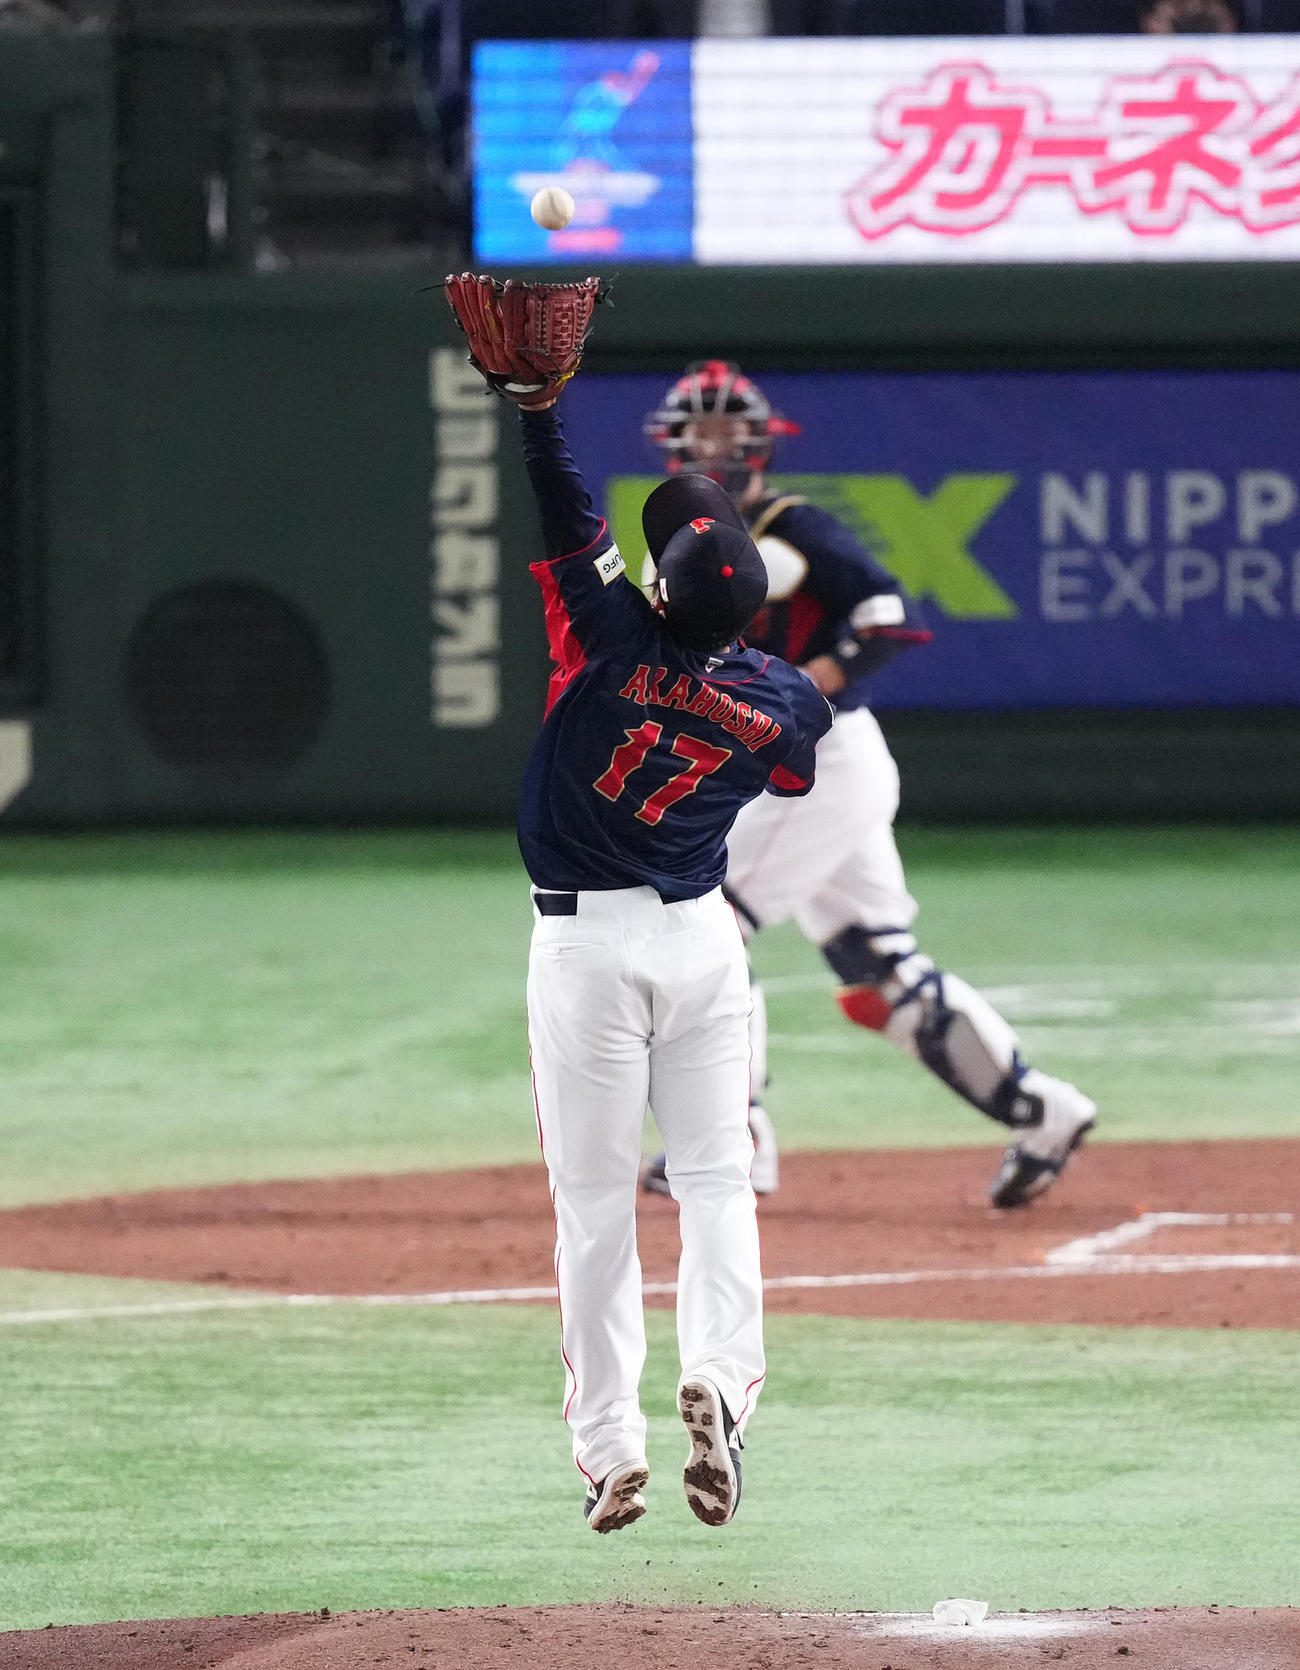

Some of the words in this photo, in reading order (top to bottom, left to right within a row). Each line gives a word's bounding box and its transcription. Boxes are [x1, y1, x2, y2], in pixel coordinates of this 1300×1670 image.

[1041, 470, 1298, 545] NIPP
[1041, 549, 1300, 622] EXPR
[593, 720, 733, 826] 17
